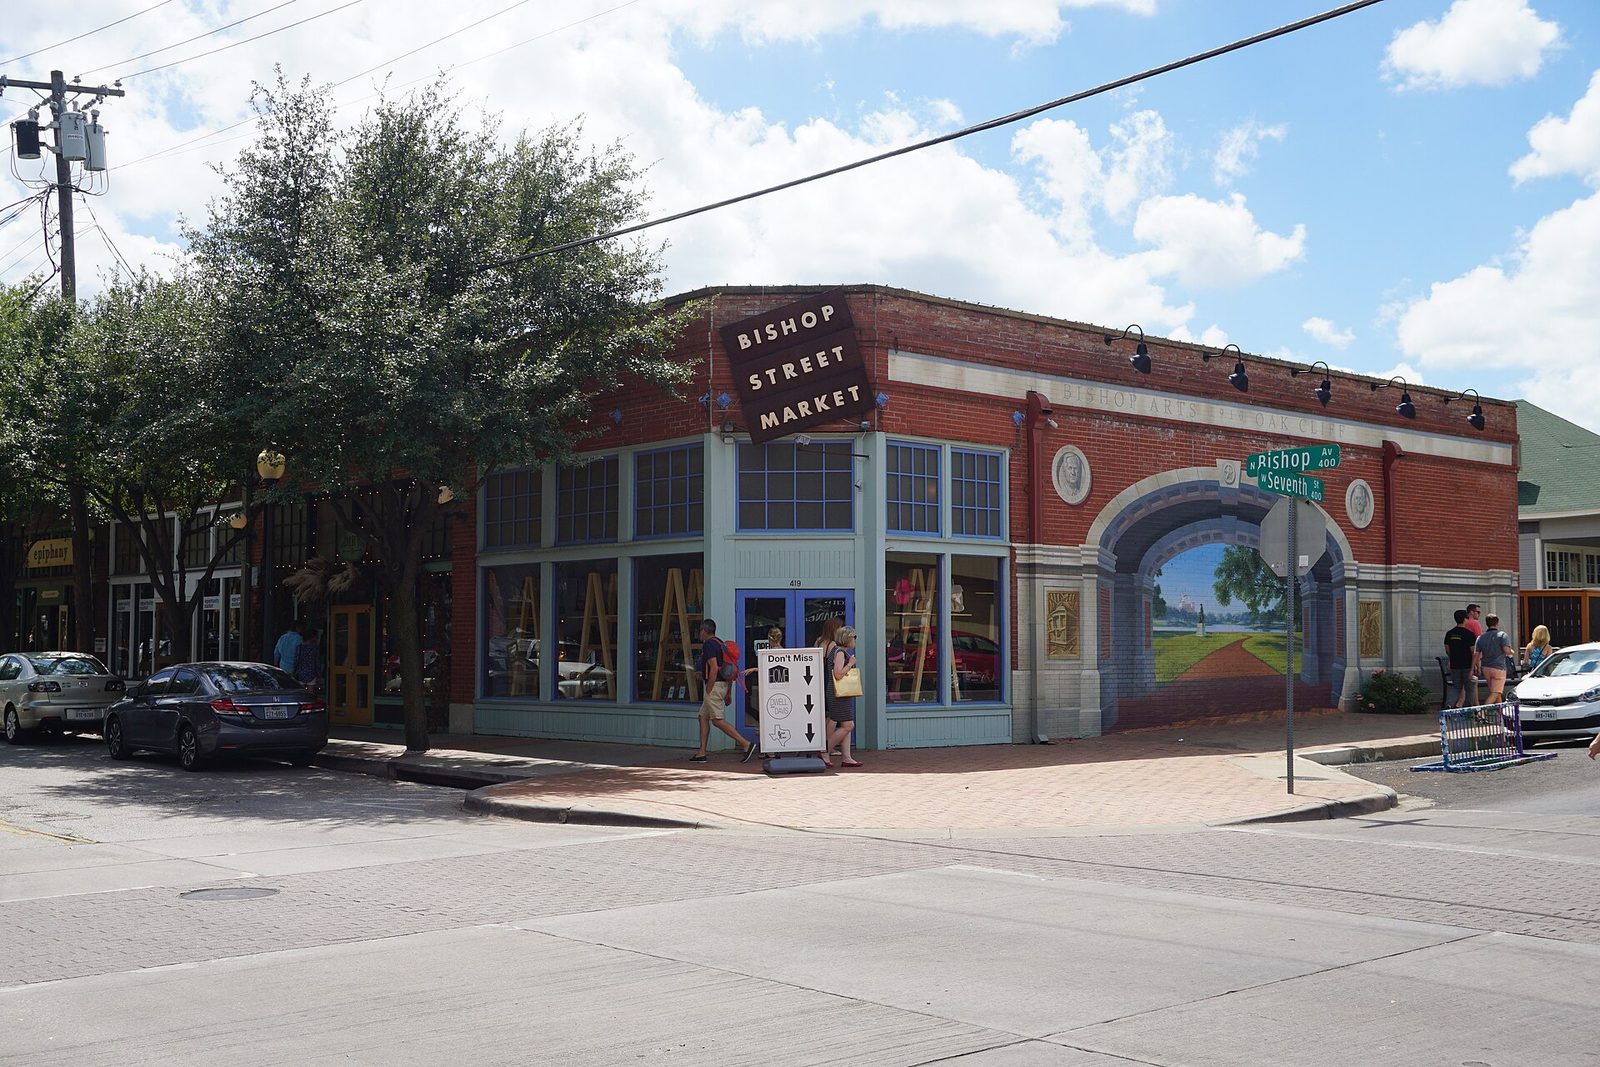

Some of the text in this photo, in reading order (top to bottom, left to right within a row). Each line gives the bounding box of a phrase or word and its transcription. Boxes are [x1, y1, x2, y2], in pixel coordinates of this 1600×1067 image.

[737, 305, 834, 350] BISHOP
[749, 346, 844, 391] STREET
[760, 385, 860, 430] MARKET
[1063, 384, 1137, 408] BISHOP
[1150, 398, 1199, 418] ARTS
[1255, 412, 1289, 431] OAK
[1299, 419, 1346, 438] CLIFF
[1250, 462, 1256, 470] N
[1258, 451, 1310, 471] Bishop
[1318, 458, 1336, 468] 400
[1261, 473, 1267, 483] W
[1267, 471, 1308, 496] Seventh
[33, 543, 69, 565] epiphany
[789, 579, 802, 588] 419
[767, 653, 814, 663] Don't Miss
